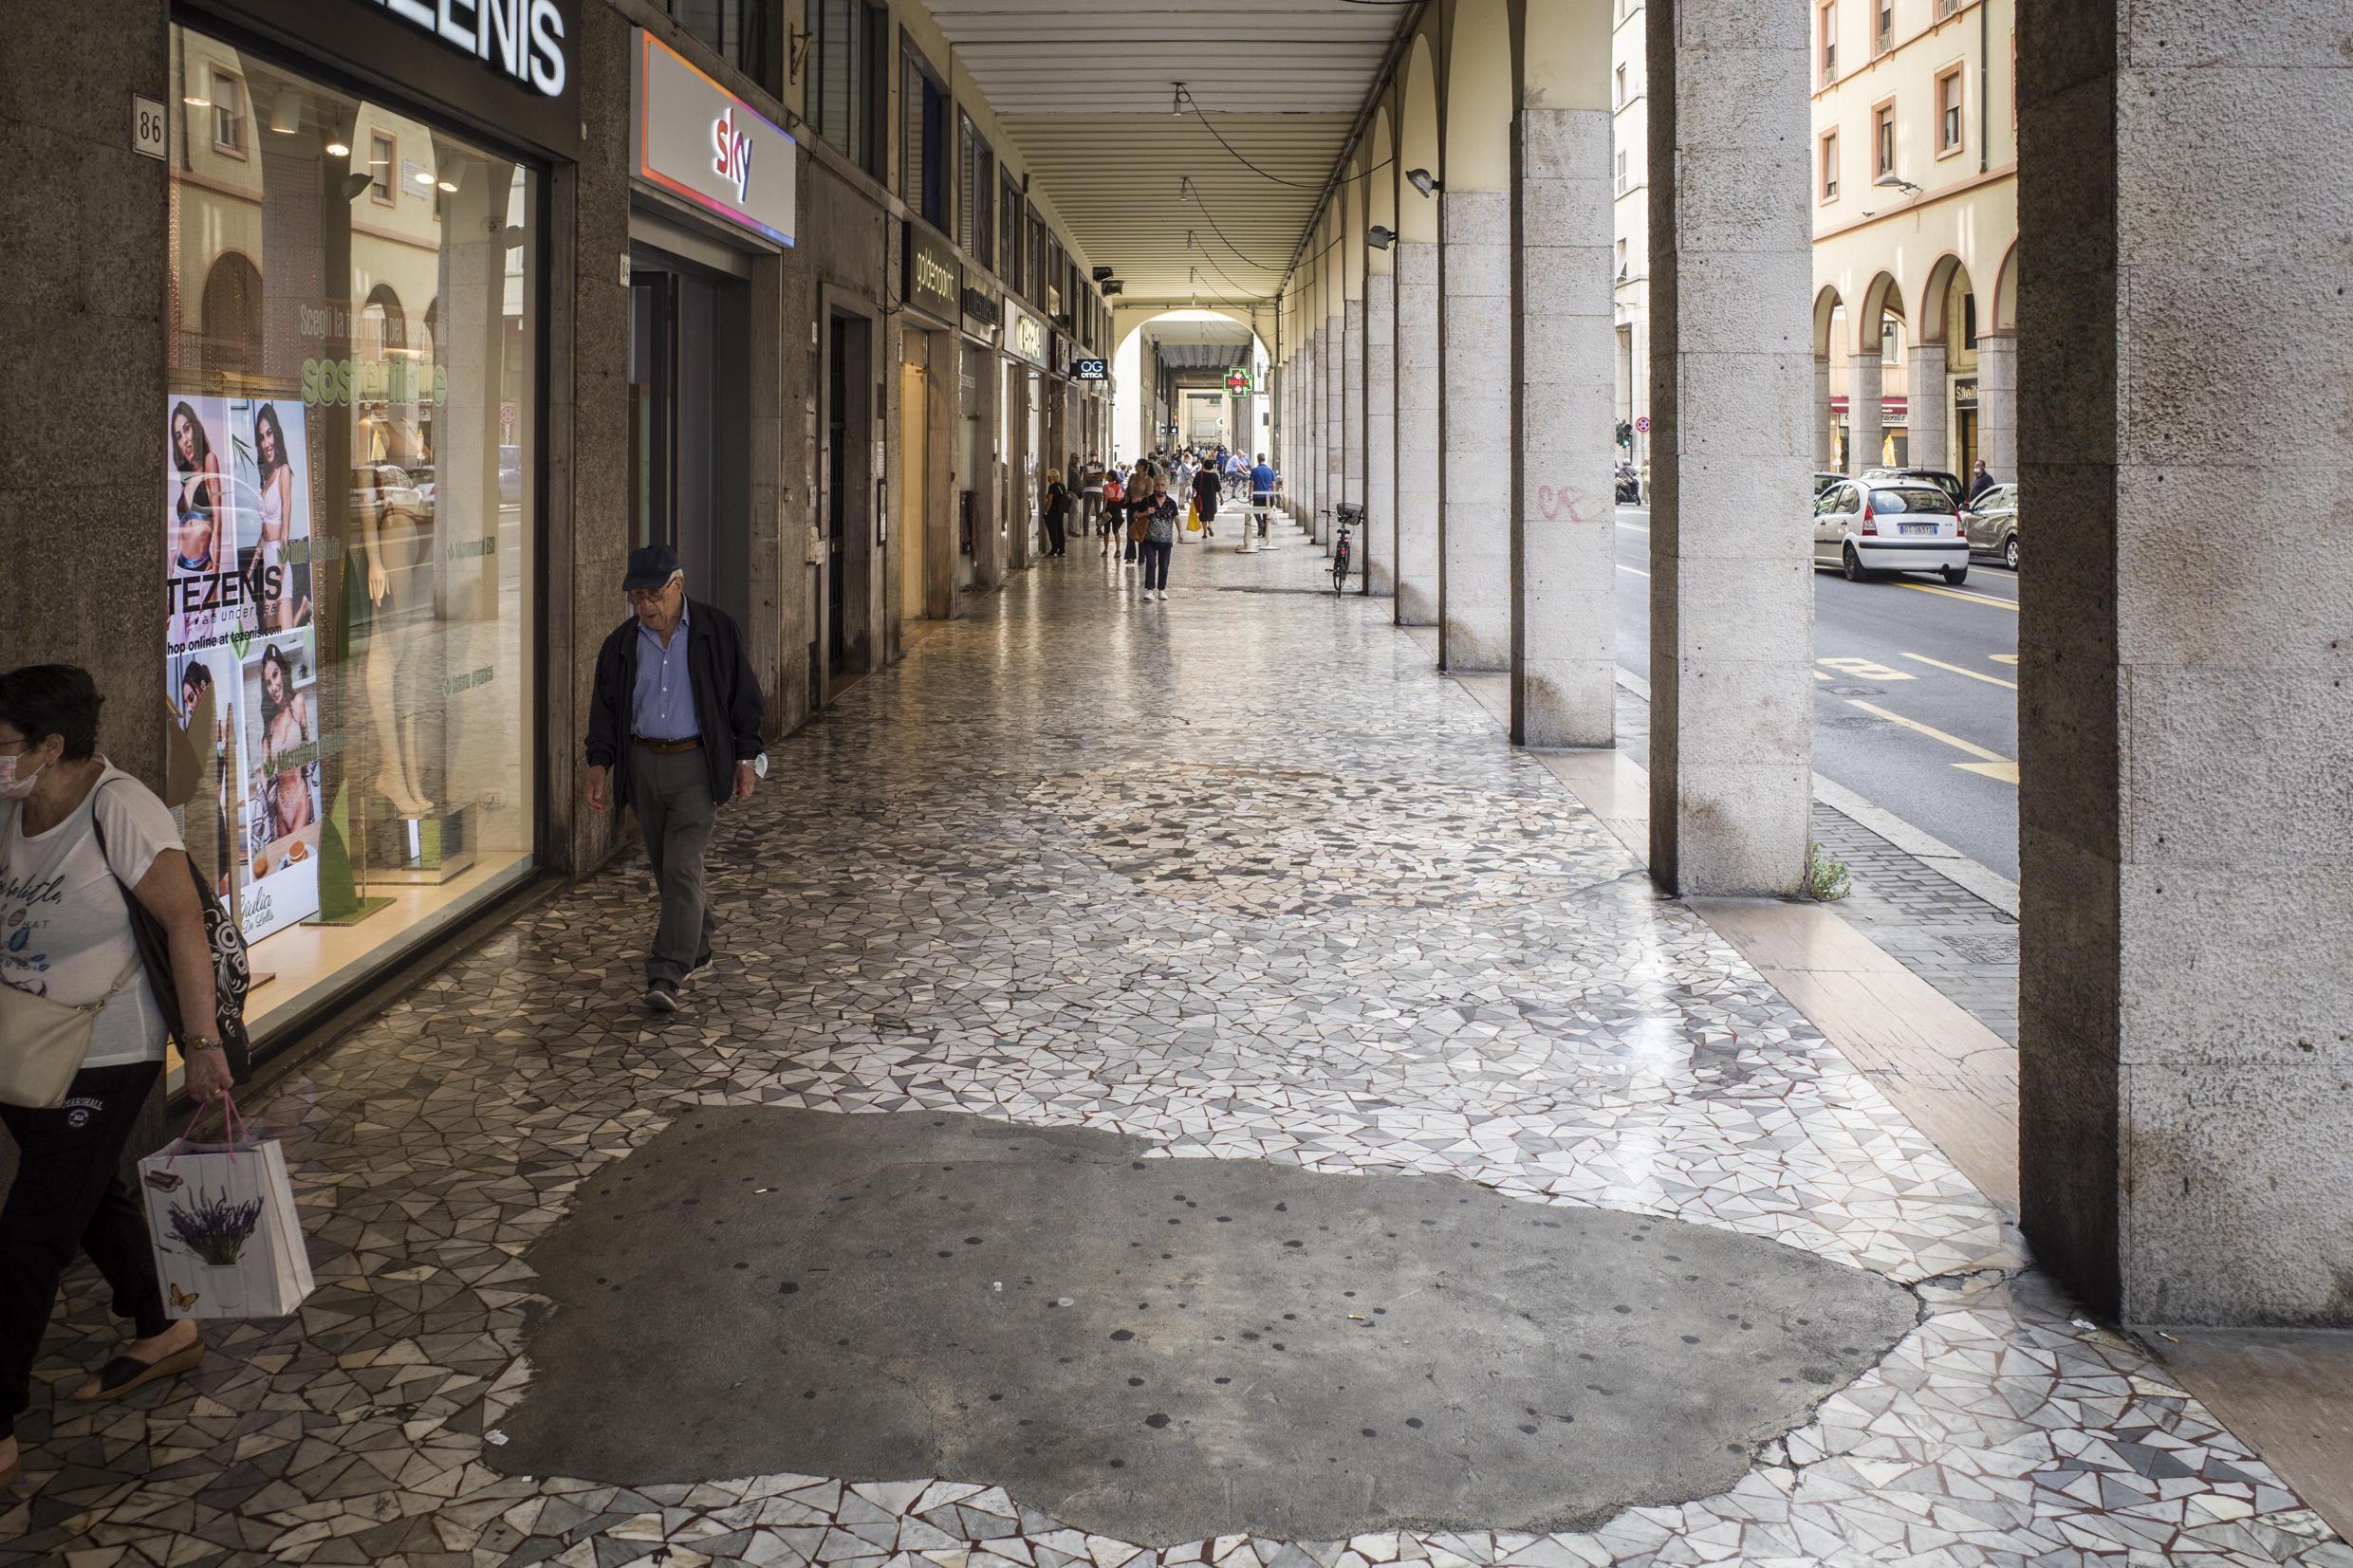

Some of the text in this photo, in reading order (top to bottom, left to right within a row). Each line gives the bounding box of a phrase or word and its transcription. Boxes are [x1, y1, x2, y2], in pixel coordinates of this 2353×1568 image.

[374, 0, 565, 96] ENIS
[140, 111, 161, 143] 86
[713, 107, 752, 203] sky
[621, 261, 629, 279] 84
[301, 304, 332, 340] Scegli
[334, 306, 343, 337] la
[389, 317, 403, 346] per
[301, 348, 448, 408] sostenibile
[167, 565, 282, 615] TEZENIS
[221, 602, 282, 621] underear
[167, 625, 282, 655] hop online at tezenis.com
